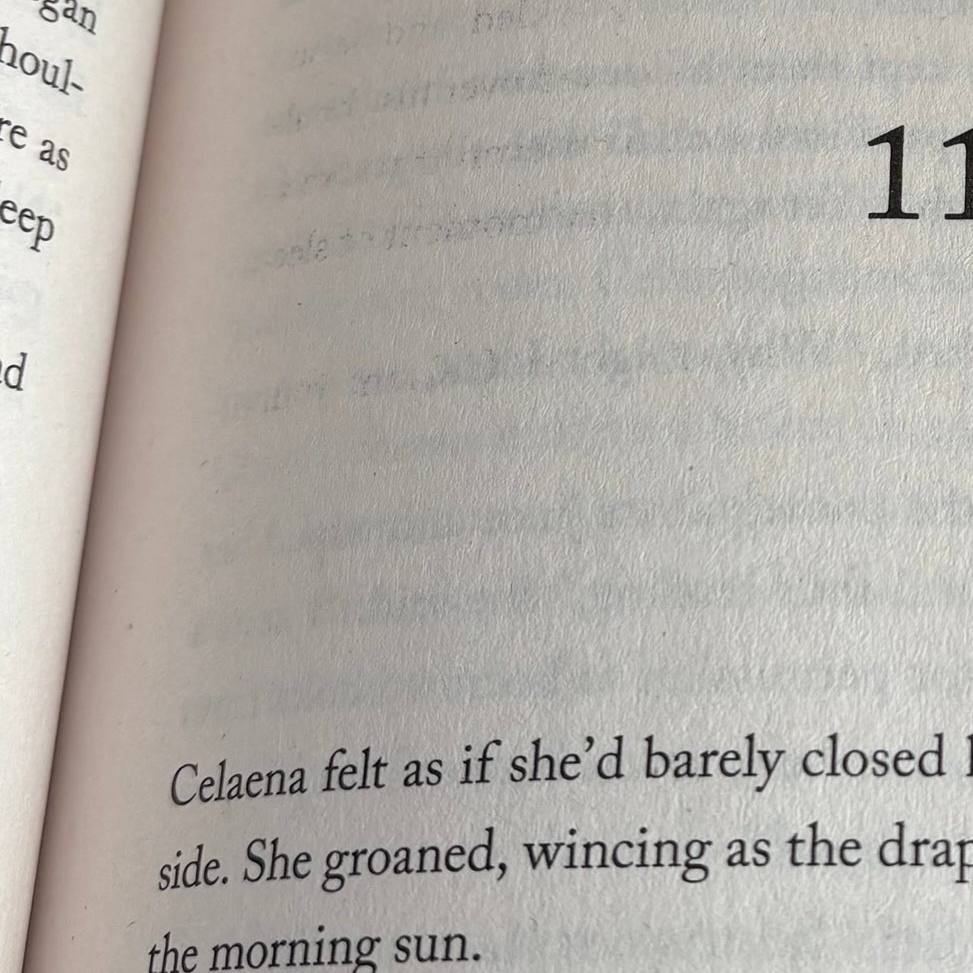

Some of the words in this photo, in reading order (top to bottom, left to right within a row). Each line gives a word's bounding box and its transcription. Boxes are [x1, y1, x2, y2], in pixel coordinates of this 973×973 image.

[39, 140, 70, 171] as
[171, 759, 307, 806] Celaena
[322, 747, 388, 792] felt
[403, 759, 442, 787] as
[460, 739, 502, 784] if
[510, 735, 624, 783] she’d
[644, 733, 786, 793] barely
[801, 732, 946, 778] closed
[159, 844, 228, 891] side.
[243, 837, 311, 882] She
[321, 826, 507, 893] groaned,
[523, 827, 713, 883] wincing
[726, 839, 771, 867] as
[786, 821, 862, 867] the
[148, 931, 198, 973] the
[209, 925, 381, 973] morning
[393, 932, 482, 965] sun.
